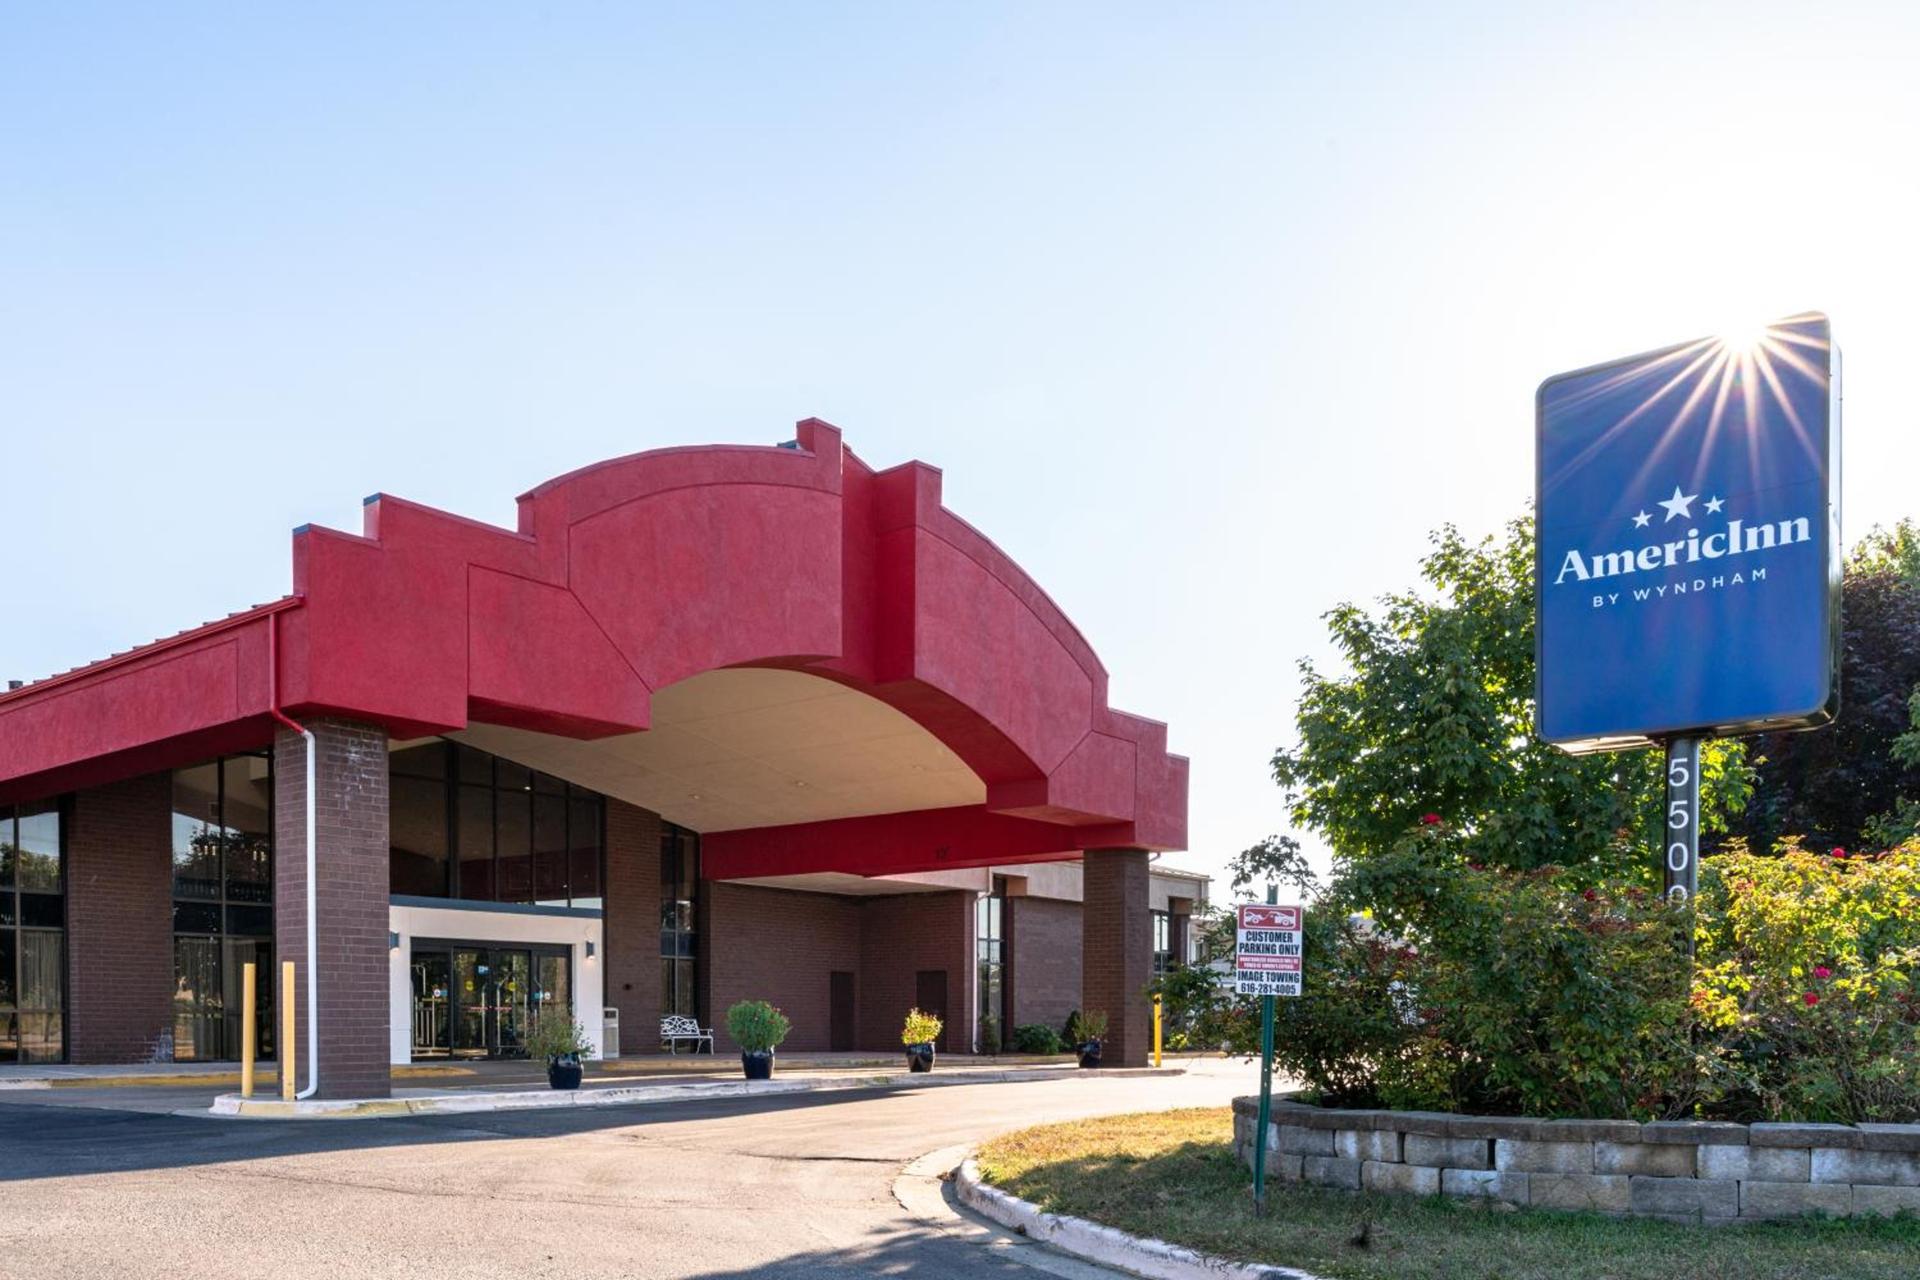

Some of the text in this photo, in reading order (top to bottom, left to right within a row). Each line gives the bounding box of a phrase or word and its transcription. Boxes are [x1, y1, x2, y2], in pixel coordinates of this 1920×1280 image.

[1553, 516, 1812, 585] AmericInn
[1592, 567, 1767, 608] BY WYNDHAM
[1246, 931, 1293, 942] CUSTOMER
[1239, 943, 1300, 955] PARKING ONLY
[1238, 971, 1300, 983] IMAGE TOWING
